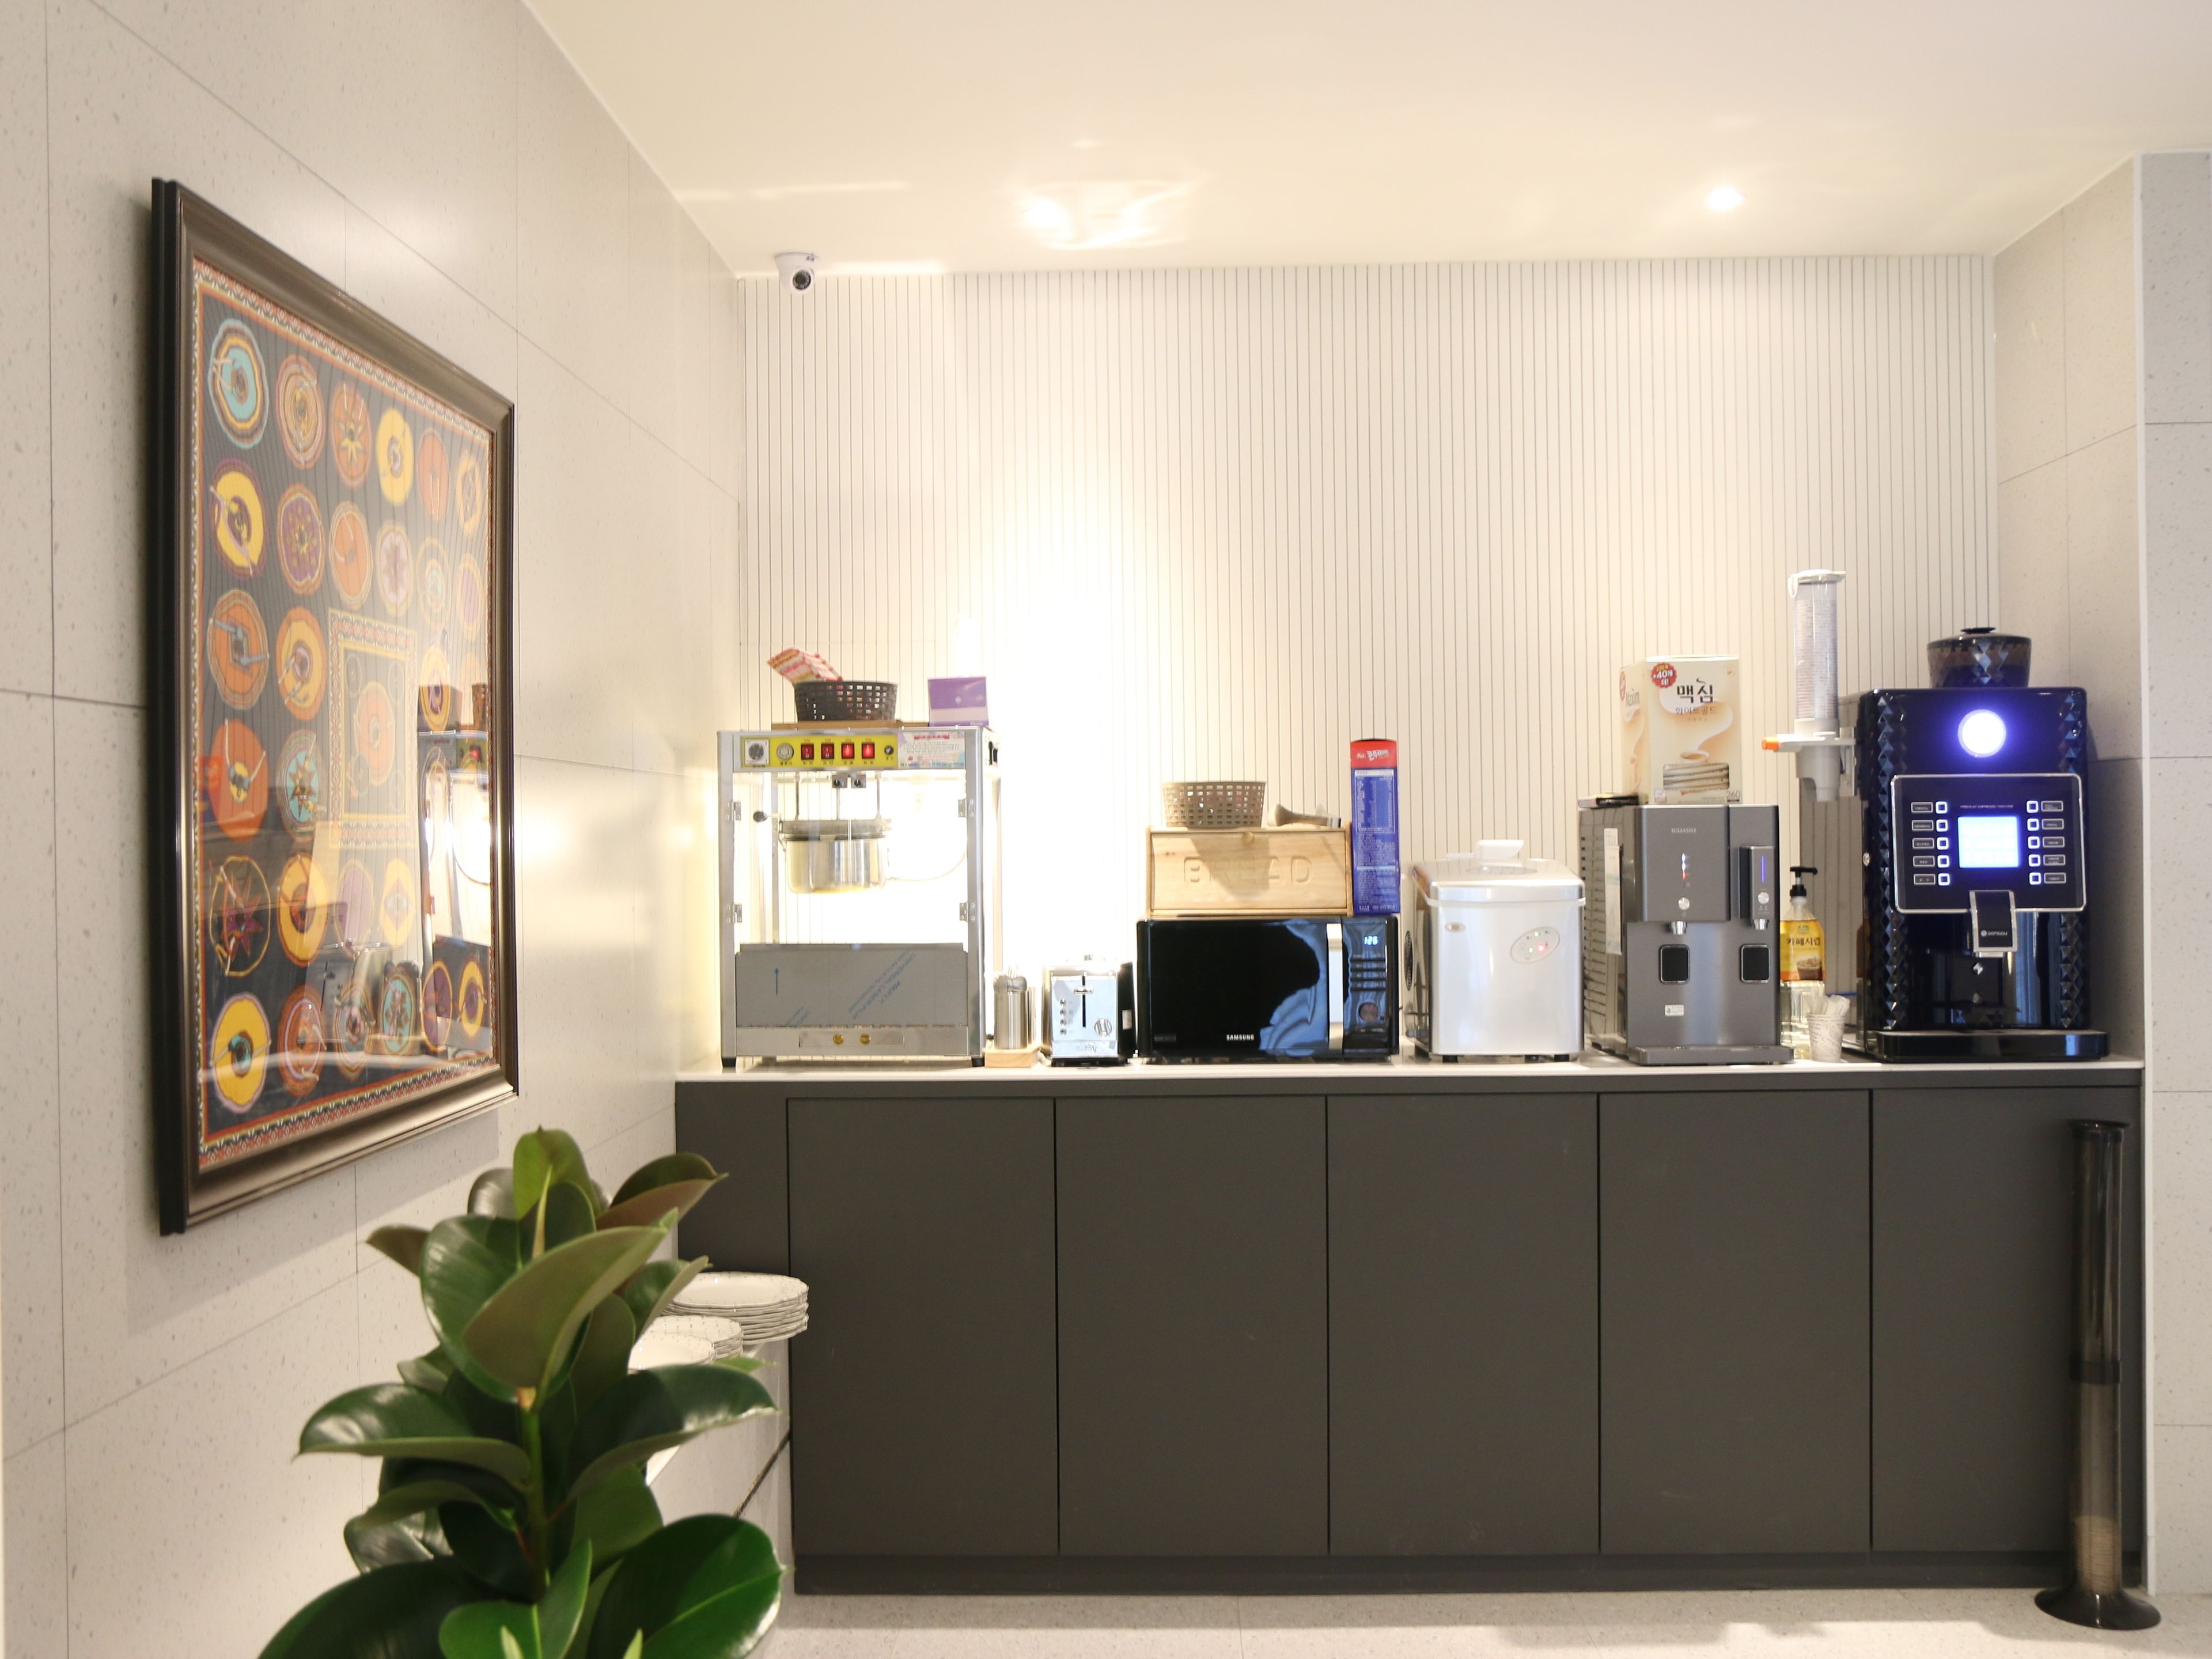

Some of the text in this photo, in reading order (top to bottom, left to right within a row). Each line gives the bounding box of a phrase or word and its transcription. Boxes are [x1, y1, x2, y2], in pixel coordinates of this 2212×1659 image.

[1677, 684, 1714, 703] 맥심
[1726, 790, 1740, 798] 260
[1183, 855, 1312, 885] BREAD
